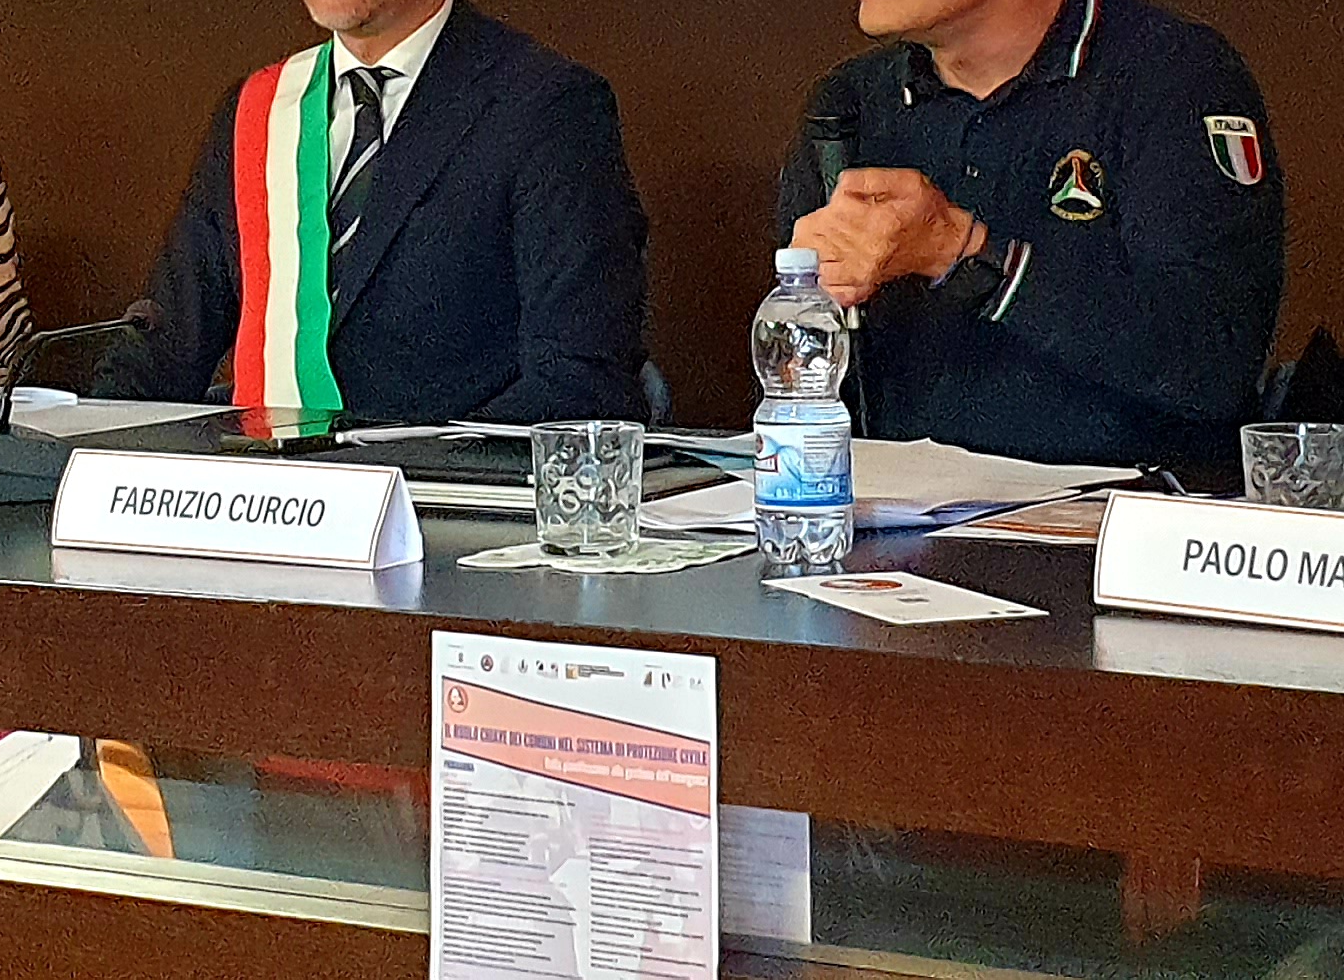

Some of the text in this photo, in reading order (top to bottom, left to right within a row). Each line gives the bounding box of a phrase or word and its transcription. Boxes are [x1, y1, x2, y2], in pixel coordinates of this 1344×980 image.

[1213, 119, 1249, 132] ITALIA
[109, 485, 326, 527] FABRIZIO CURCIO
[1182, 538, 1288, 582] PAOLO
